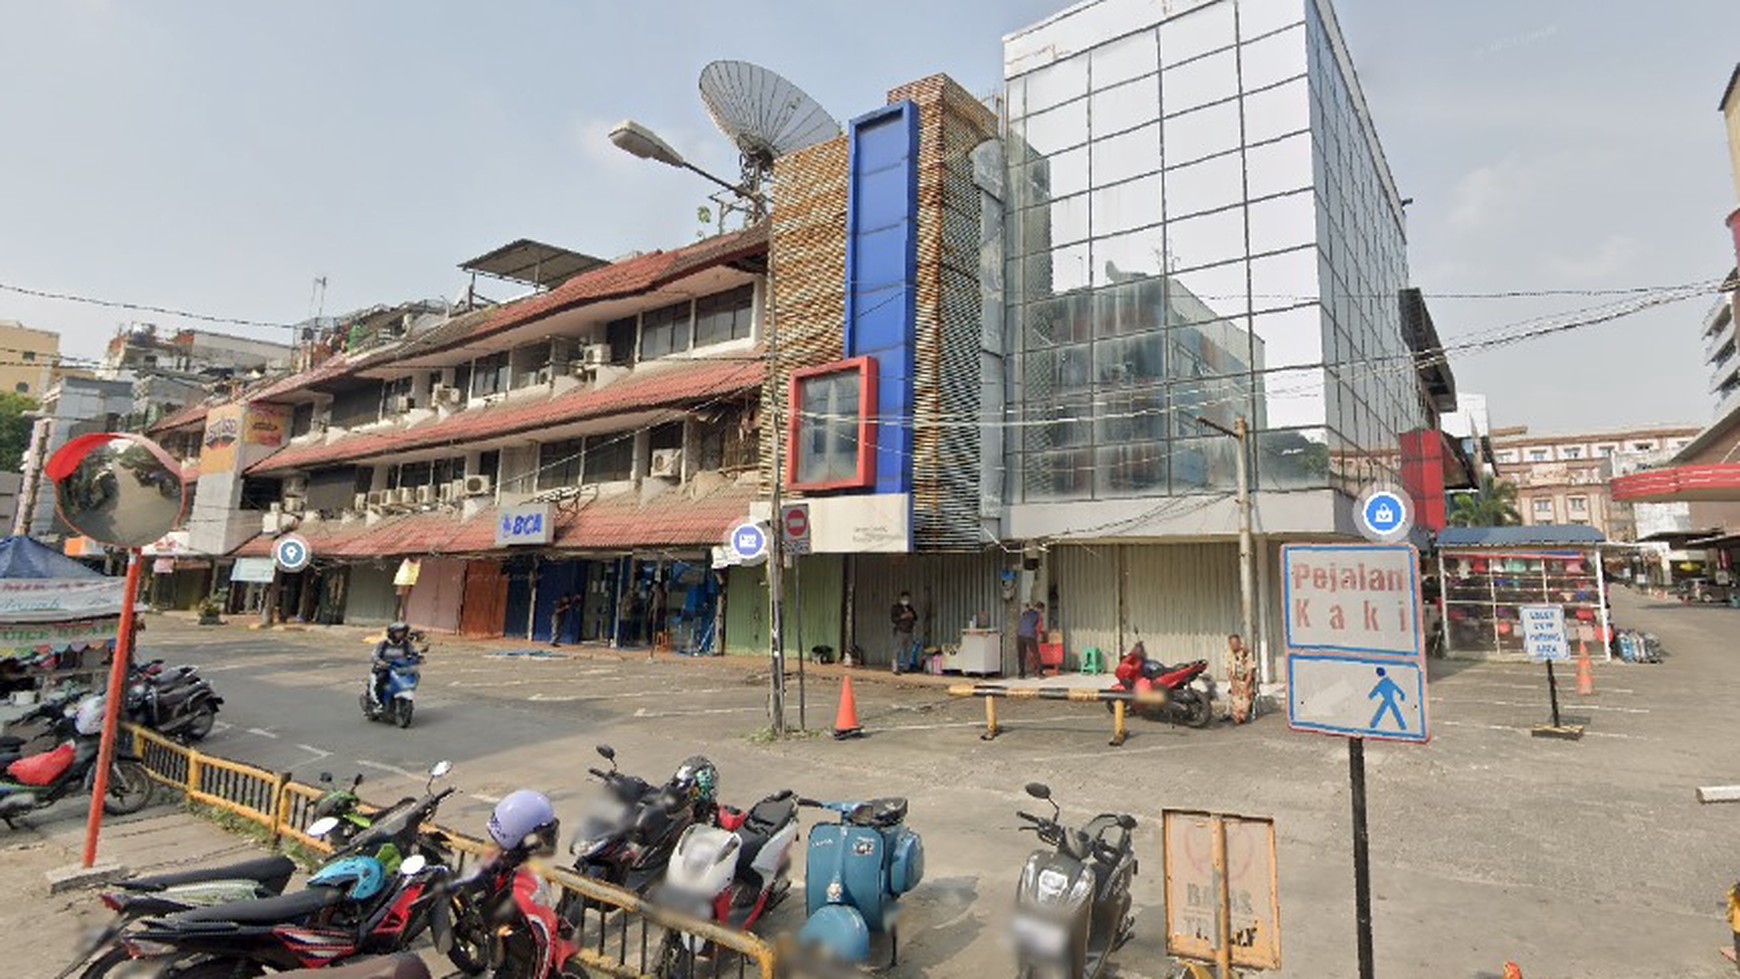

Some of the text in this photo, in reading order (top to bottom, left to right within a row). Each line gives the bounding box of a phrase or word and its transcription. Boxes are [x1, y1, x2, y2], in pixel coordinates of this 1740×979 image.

[512, 513, 542, 535] BCA
[1293, 562, 1404, 592] Pejalan
[1296, 598, 1406, 632] Kaki
